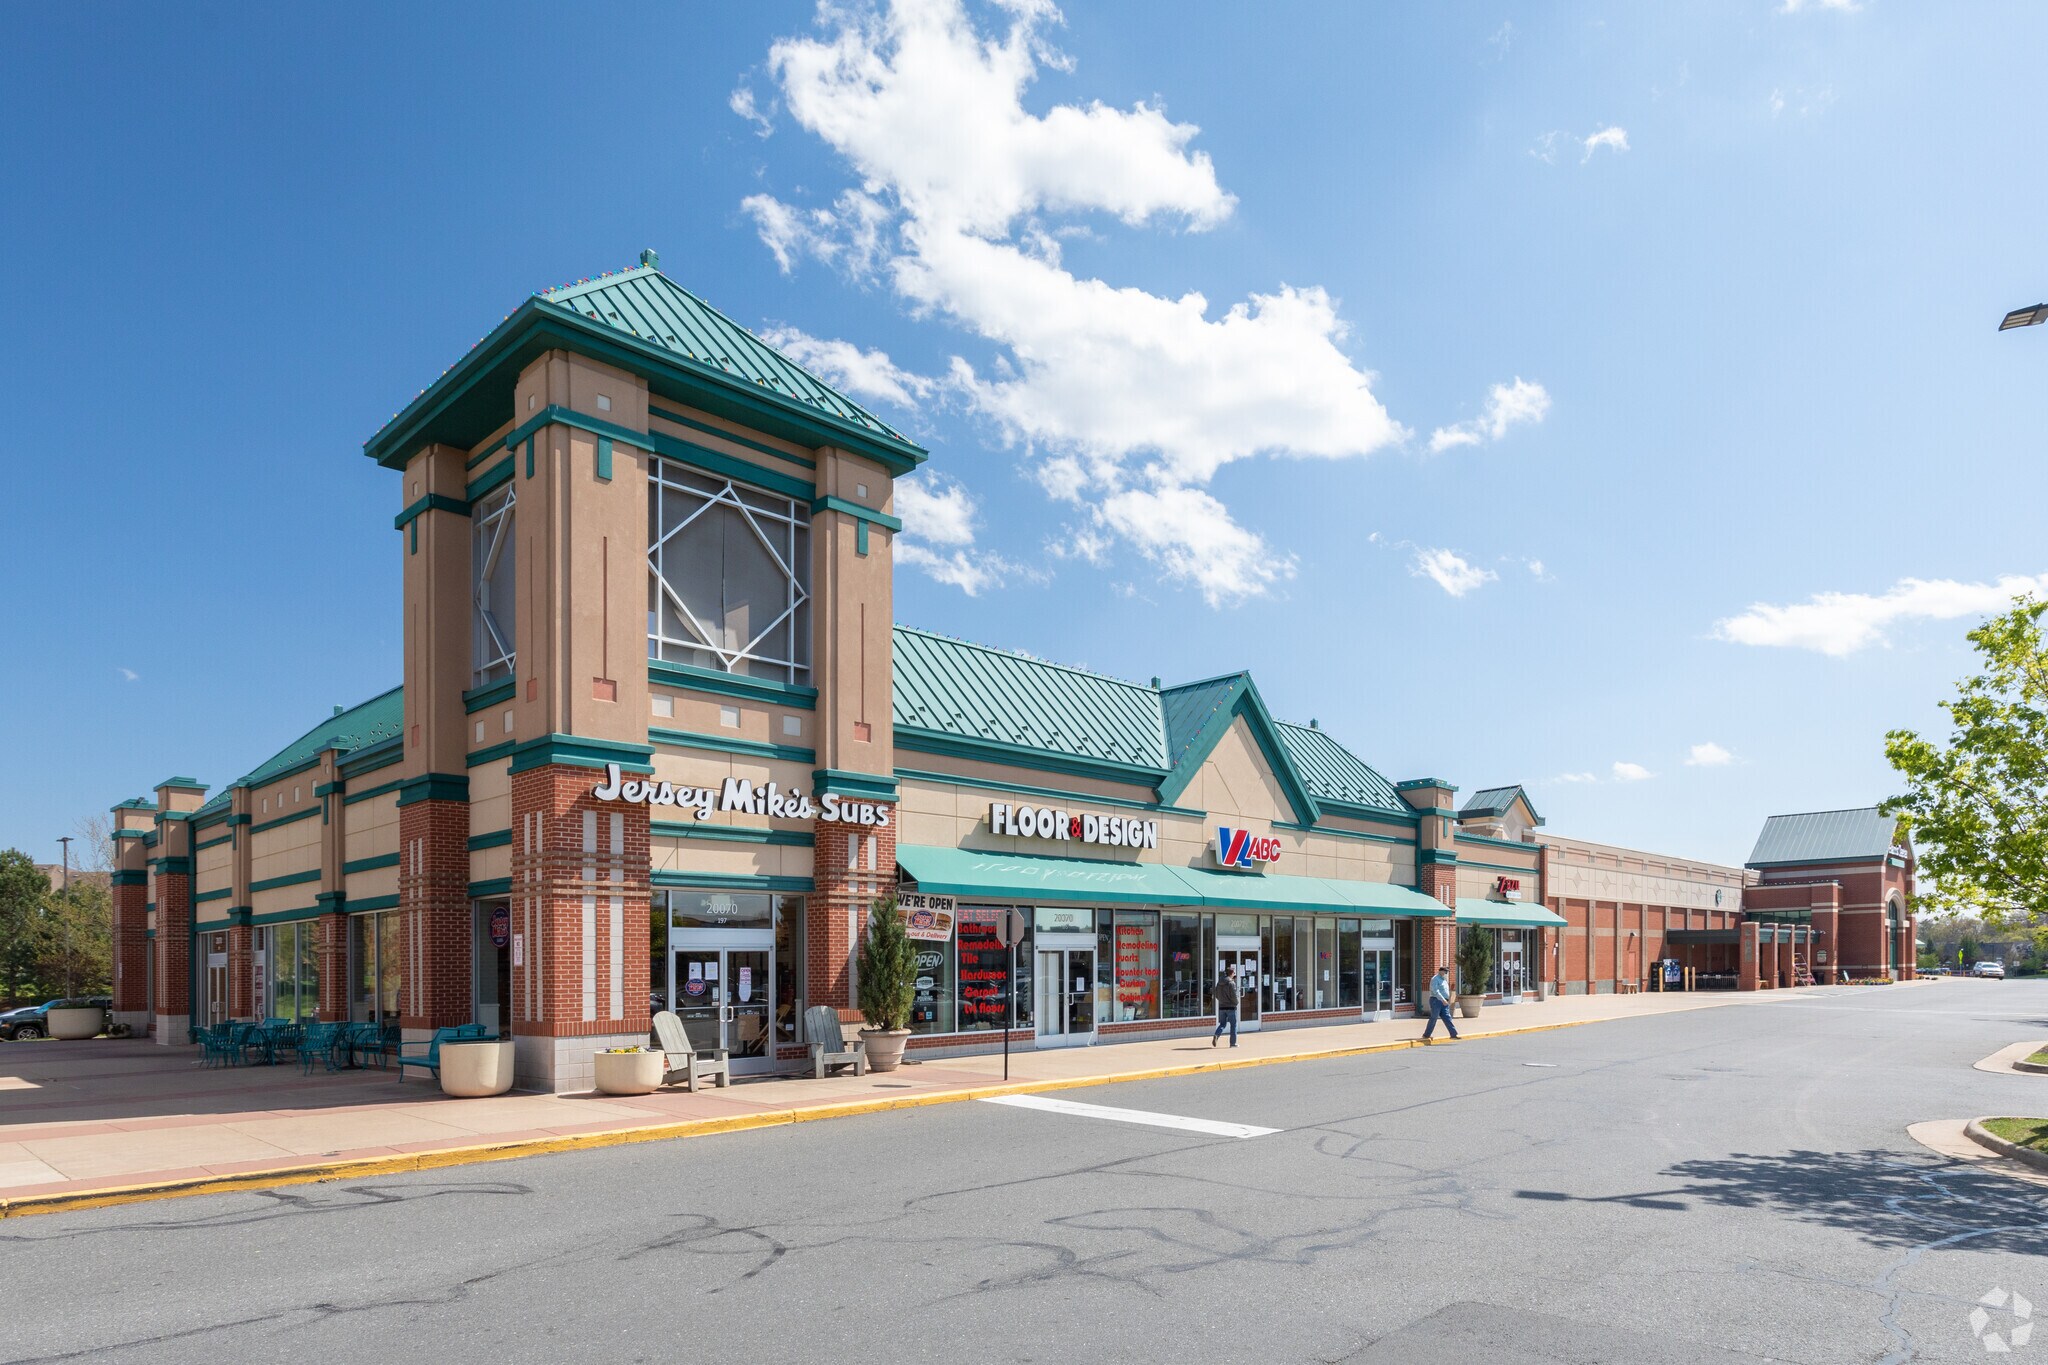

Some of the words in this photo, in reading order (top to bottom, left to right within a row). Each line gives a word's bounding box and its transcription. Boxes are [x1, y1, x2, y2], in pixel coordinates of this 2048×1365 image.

[591, 763, 715, 820] Jersey
[717, 777, 817, 819] Mike's
[989, 803, 1070, 841] FLOOR
[1071, 817, 1082, 838] &
[1080, 814, 1158, 849] DESIGN
[1246, 837, 1281, 863] ABC
[897, 893, 925, 908] WE'RE
[929, 896, 953, 910] OPEN
[706, 903, 738, 915] 20070
[957, 921, 998, 934] Bathroo
[1116, 926, 1144, 936] Kitchen
[926, 932, 948, 940] Delivery
[1115, 940, 1158, 952] Remodeling
[914, 954, 940, 967] OPEN
[961, 952, 979, 964] Tile
[1120, 979, 1146, 988] Custom
